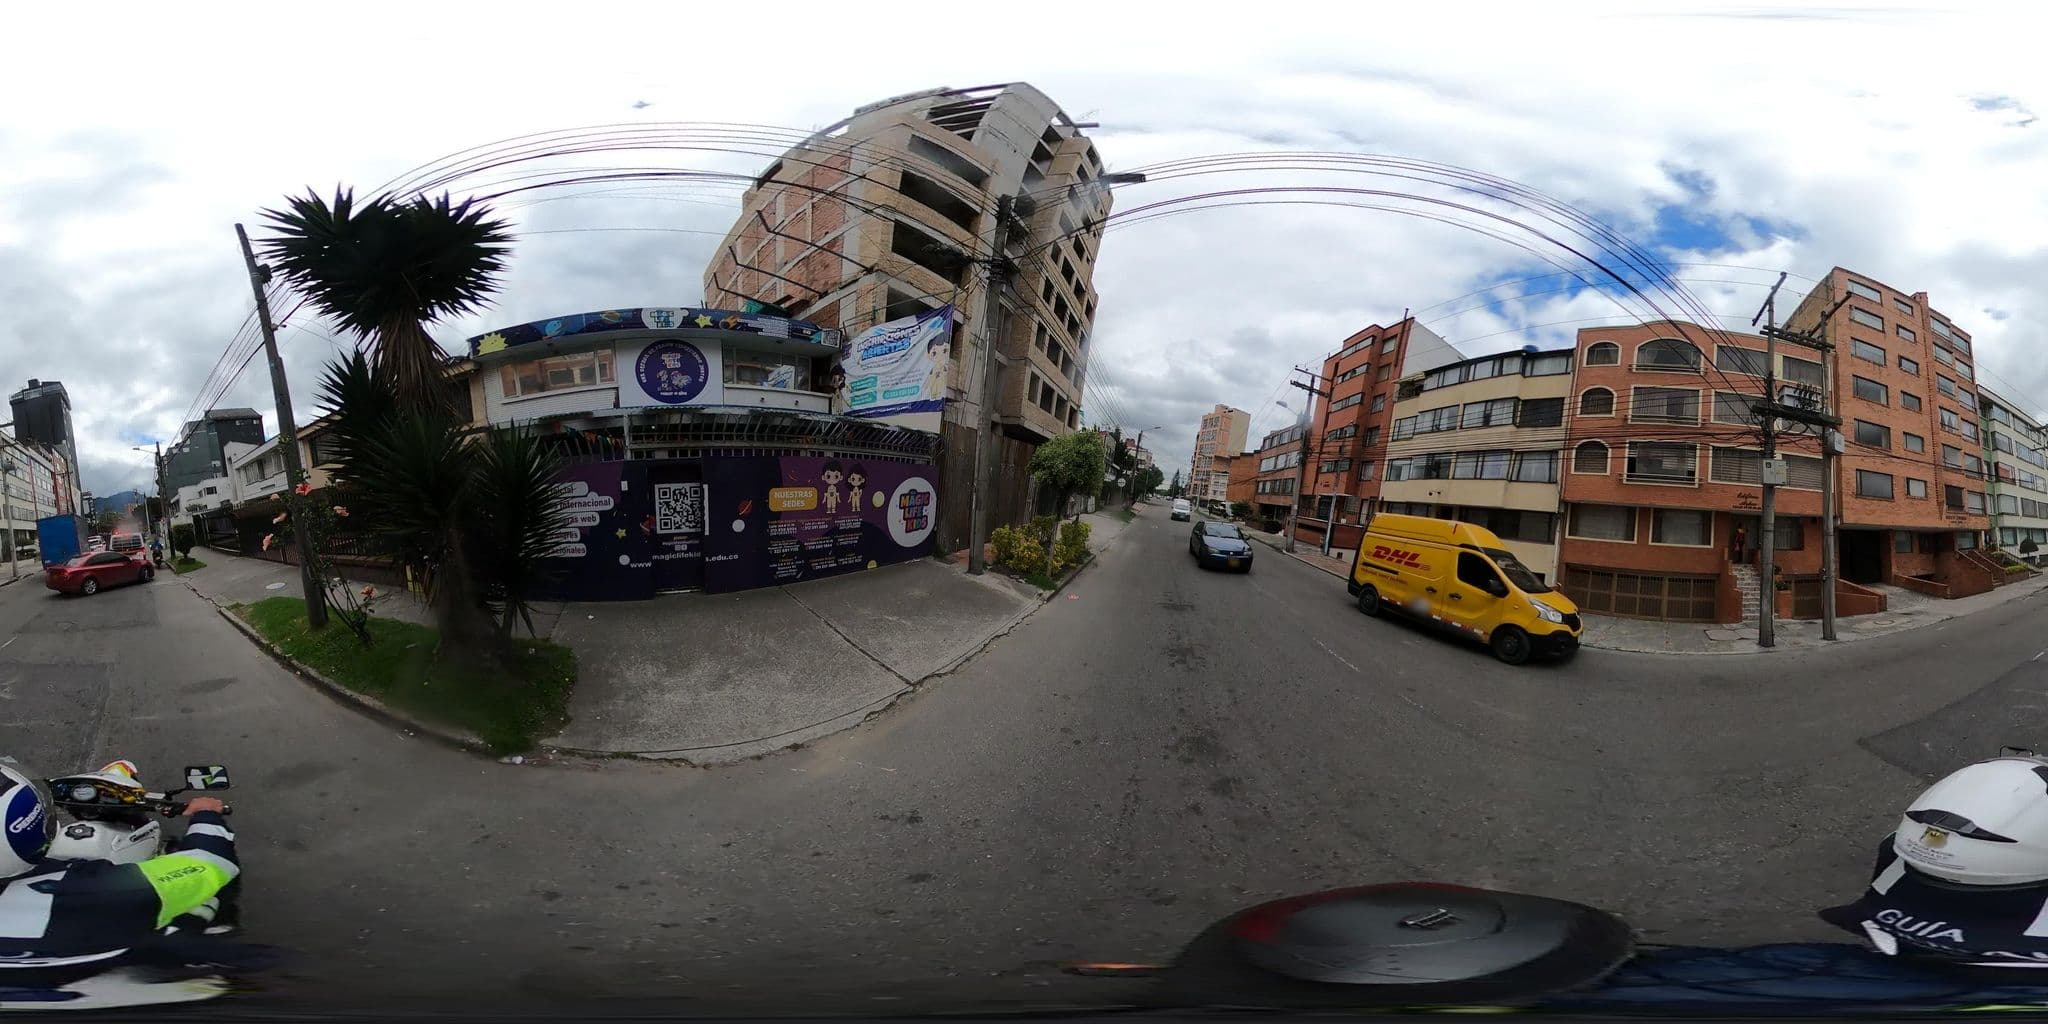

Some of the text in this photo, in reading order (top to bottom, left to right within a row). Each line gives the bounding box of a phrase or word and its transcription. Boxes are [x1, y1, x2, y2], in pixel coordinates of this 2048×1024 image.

[774, 490, 814, 499] NUESTRAS
[899, 491, 930, 510] MAGIC
[782, 498, 806, 508] SEDES
[580, 514, 598, 523] web
[903, 506, 924, 520] LIFE
[905, 515, 928, 533] KIDS
[1372, 545, 1421, 568] DHL
